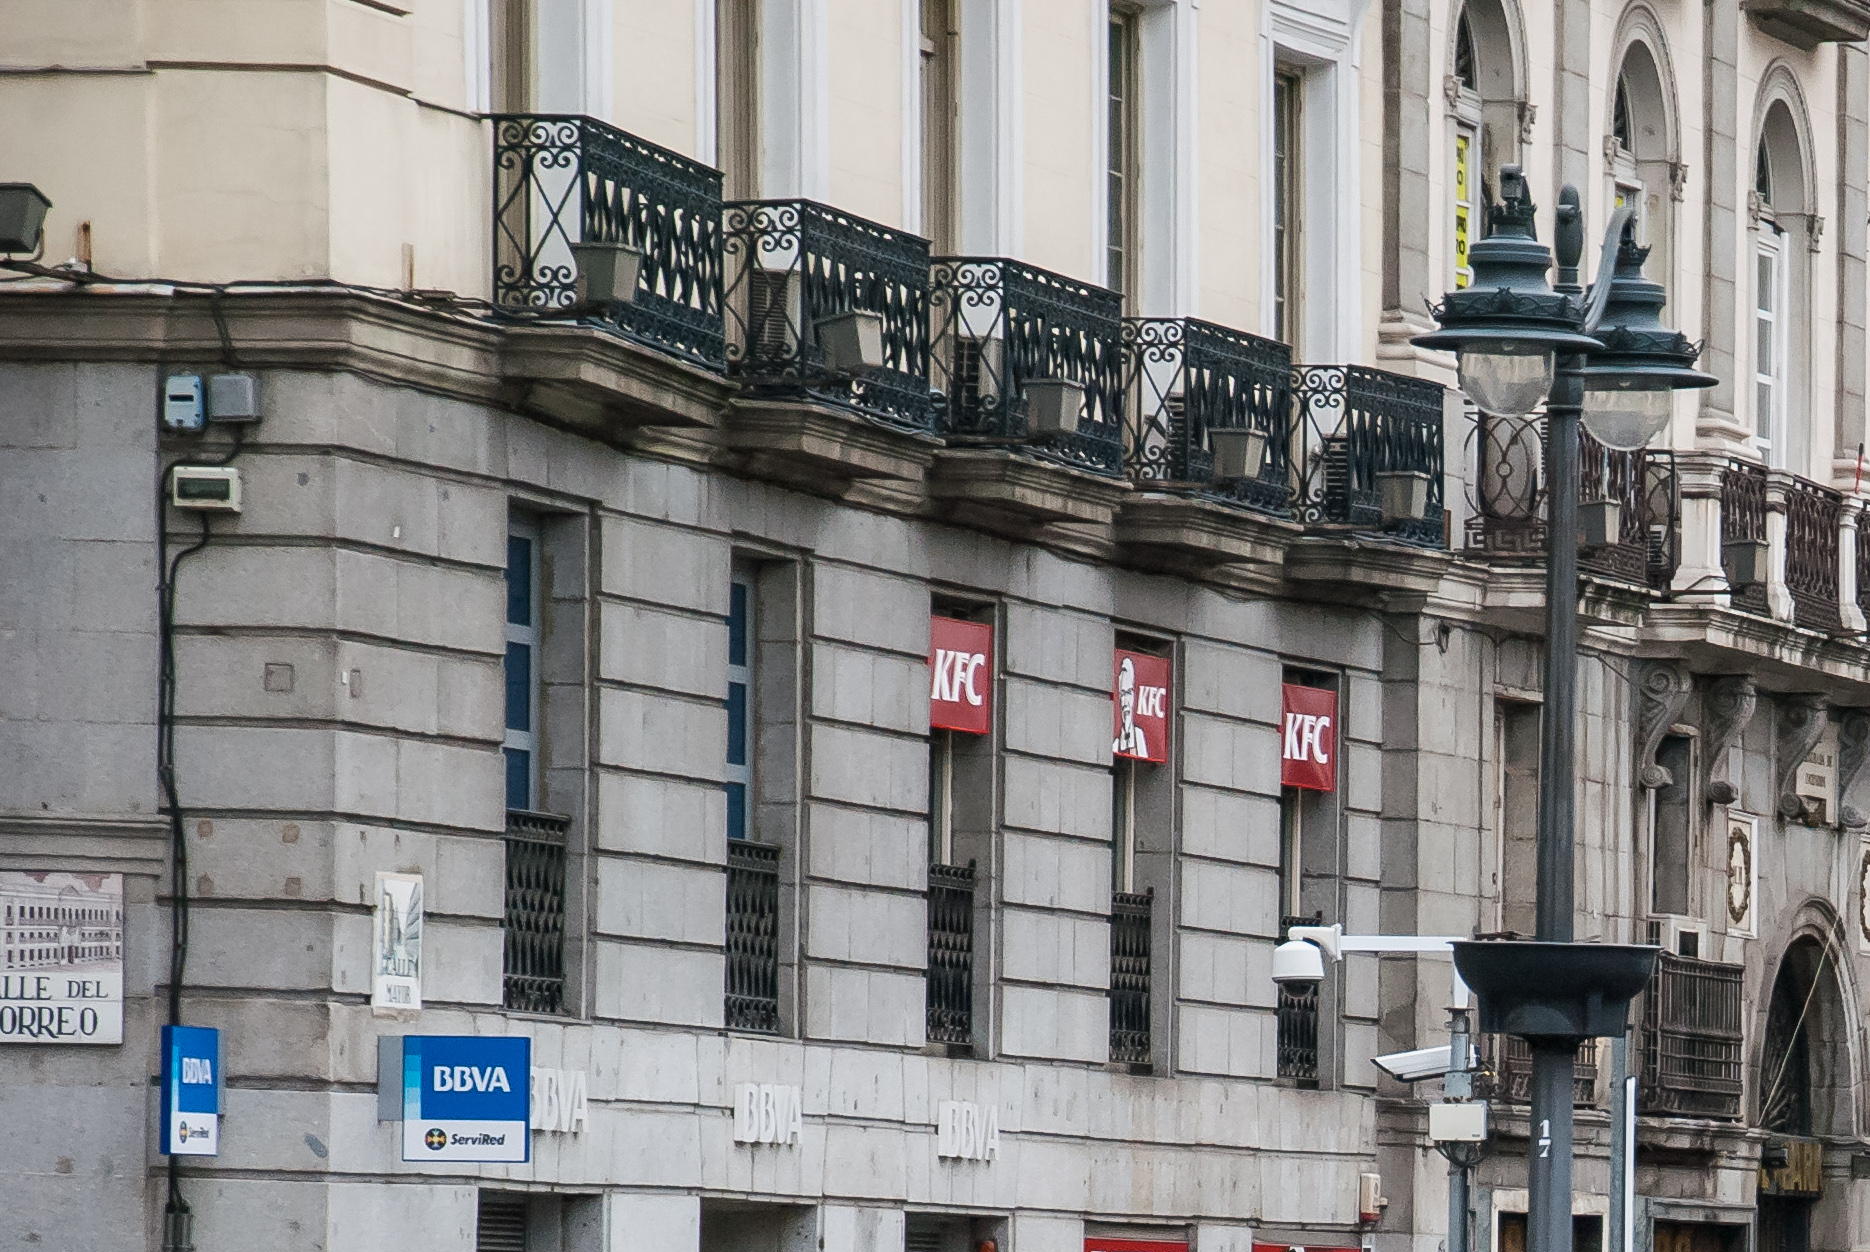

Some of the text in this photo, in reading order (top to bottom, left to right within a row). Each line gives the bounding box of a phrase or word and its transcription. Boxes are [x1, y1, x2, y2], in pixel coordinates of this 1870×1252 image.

[931, 648, 986, 707] KFC
[1136, 685, 1167, 719] KFC
[1283, 712, 1331, 765] KFC
[0, 975, 109, 1001] LLE DEL
[0, 1005, 99, 1039] ORREO
[181, 1057, 212, 1085] BBVA
[433, 1065, 511, 1092] BBVA
[734, 1083, 803, 1144] BBVA
[938, 1100, 1000, 1161] BBVA
[450, 1132, 505, 1146] ServiRed
